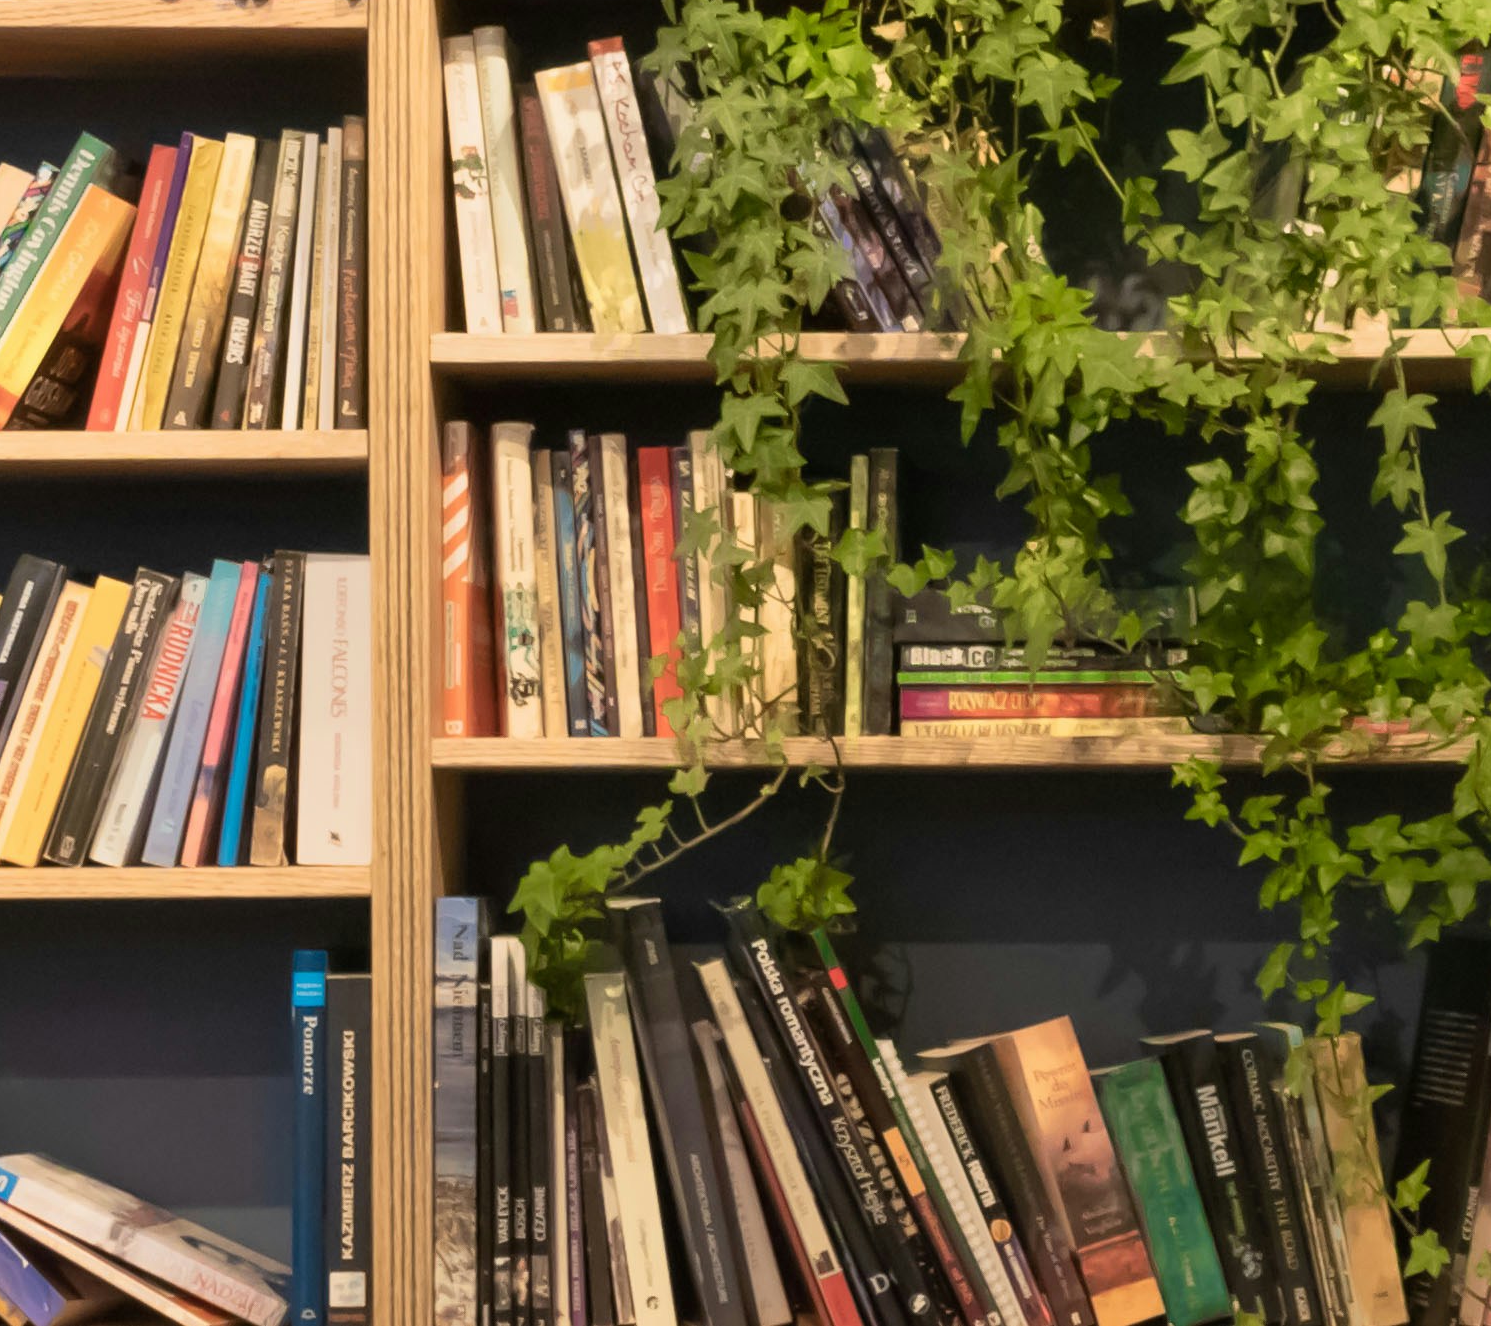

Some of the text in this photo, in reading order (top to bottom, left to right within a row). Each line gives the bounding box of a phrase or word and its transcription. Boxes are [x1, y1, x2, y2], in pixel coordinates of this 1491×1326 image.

[44, 146, 98, 220] Dennis
[43, 248, 85, 304] GRISHAM
[233, 198, 271, 298] ANDRZEJ BART
[137, 620, 195, 725] RUDNICKA
[269, 559, 296, 753] STARA KRASZEWSKI
[329, 639, 350, 718] FALCONES
[909, 644, 963, 664] Black
[450, 923, 471, 1059] Nad Niemnem
[298, 1015, 319, 1095] Pomorze
[747, 935, 893, 1228] Polska romantyczna Krzysztof Hejke
[340, 1029, 356, 1259] KAZIMIERZ BARCIKOWSKI
[929, 1082, 1001, 1210] FREDERICK FORSYTH
[1185, 1083, 1245, 1179] Mankell
[1238, 1048, 1301, 1272] CORMAC McCARTHY ROAD
[496, 1185, 509, 1243] VAN EYCK
[513, 1197, 527, 1239] BOSCH
[686, 1151, 730, 1305] ARCHITEKTURA ARCHITECTURE
